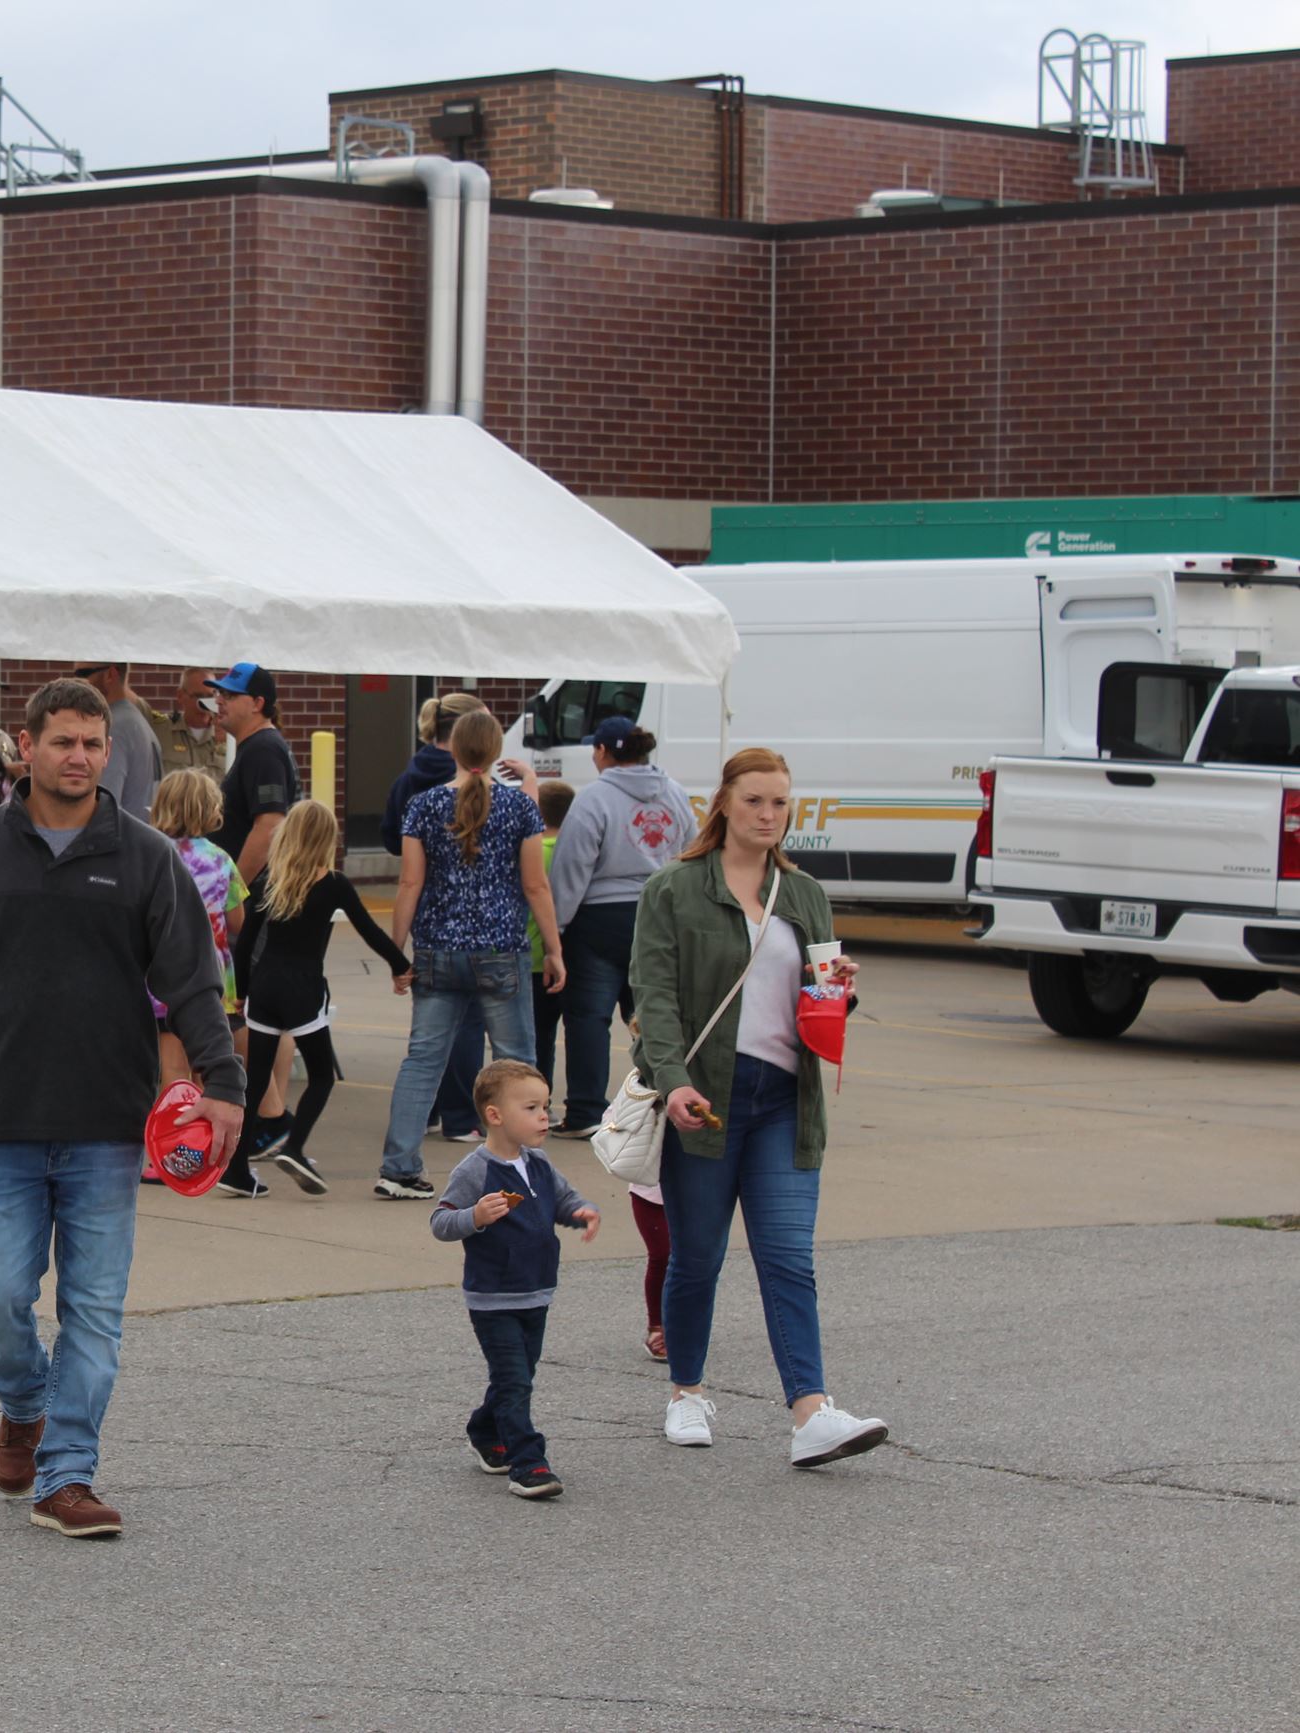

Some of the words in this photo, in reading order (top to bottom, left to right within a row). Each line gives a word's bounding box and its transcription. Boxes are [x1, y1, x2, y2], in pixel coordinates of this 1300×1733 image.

[1058, 531, 1091, 542] Power
[1058, 541, 1116, 552] Generation
[781, 835, 832, 849] OUNTY
